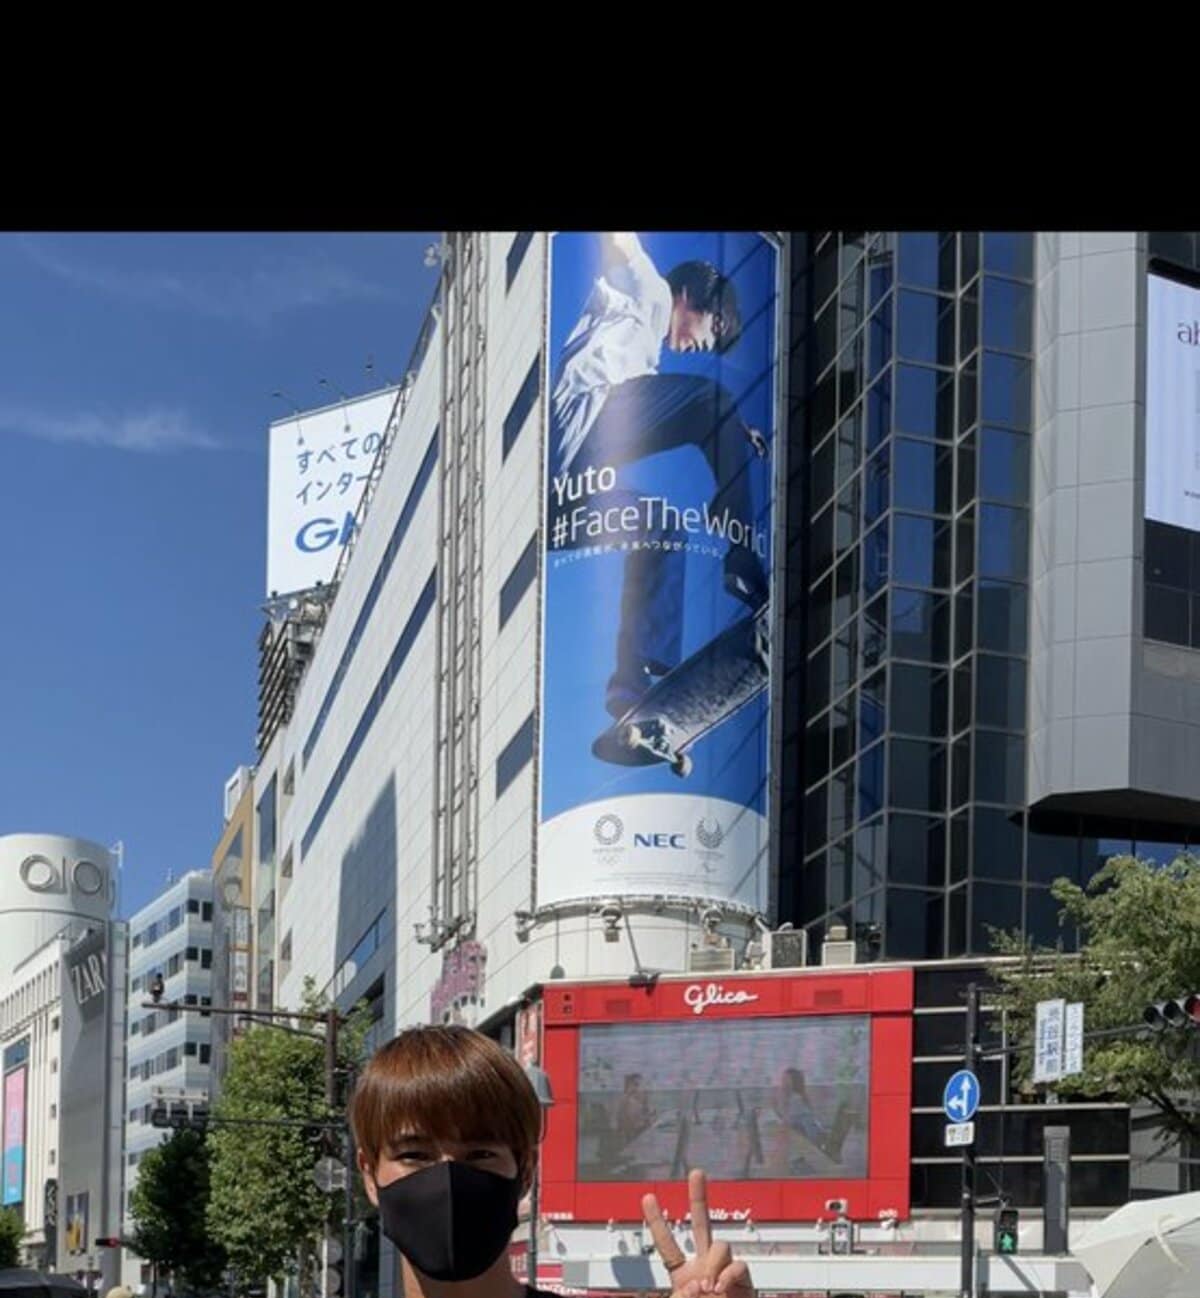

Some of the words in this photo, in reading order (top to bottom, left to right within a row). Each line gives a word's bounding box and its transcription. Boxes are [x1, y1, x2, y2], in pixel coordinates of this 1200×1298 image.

[297, 432, 382, 475] すべての
[553, 465, 616, 507] Yuto
[552, 496, 768, 559] #FaceTheWorld
[633, 833, 687, 850] NEC
[72, 951, 106, 1005] ZAR
[684, 983, 758, 1014] Glico
